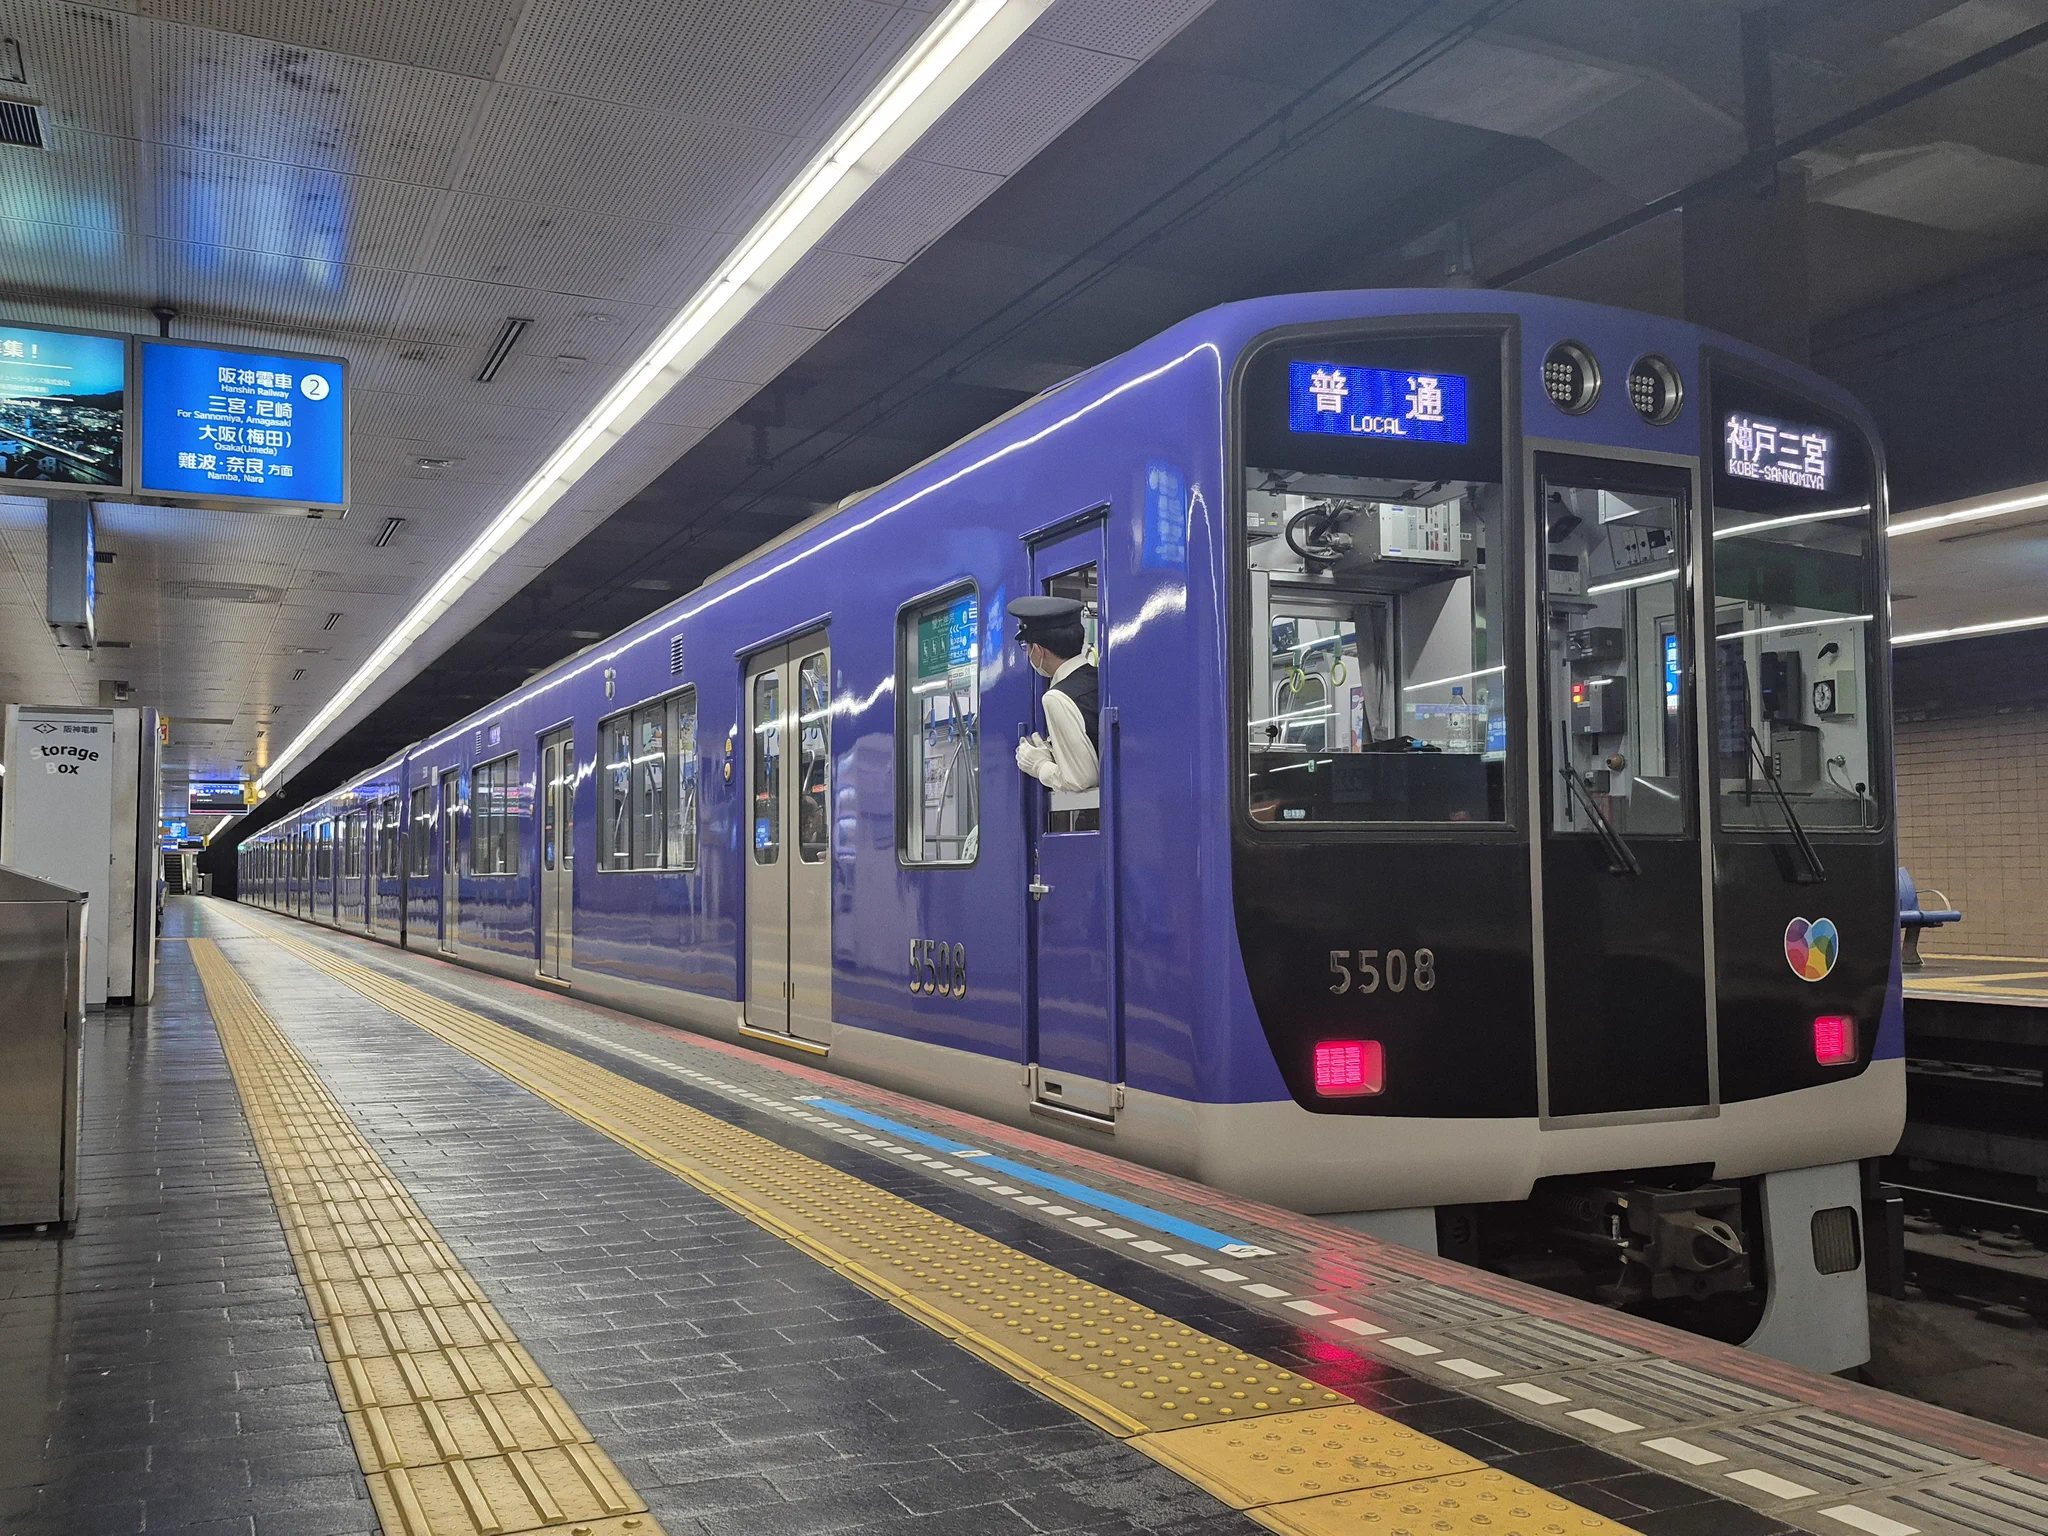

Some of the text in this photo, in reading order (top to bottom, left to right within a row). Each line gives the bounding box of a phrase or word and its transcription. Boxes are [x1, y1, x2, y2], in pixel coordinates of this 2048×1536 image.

[0, 340, 39, 359] 集！
[218, 367, 293, 389] 阪神電車
[221, 384, 290, 399] Hanshin Railway
[208, 395, 293, 419] 三宮・尼崎
[177, 409, 292, 427] For Sannomiya, Amagasaki
[1350, 415, 1408, 435] LOCAL
[198, 424, 292, 448] 大阪(梅田)
[1726, 415, 1827, 476] 神戸三宮
[214, 442, 278, 456] Osaka(Umeda)
[178, 452, 293, 477] 難波・奈良 方面
[1729, 459, 1825, 490] KOBE-SANNOMIYA
[207, 471, 265, 484] Namba, Nara
[63, 725, 98, 734] 阪神電車
[29, 745, 99, 762] Storage
[45, 762, 80, 775] Box
[909, 938, 967, 1000] 5508
[1329, 948, 1436, 995] 5508
